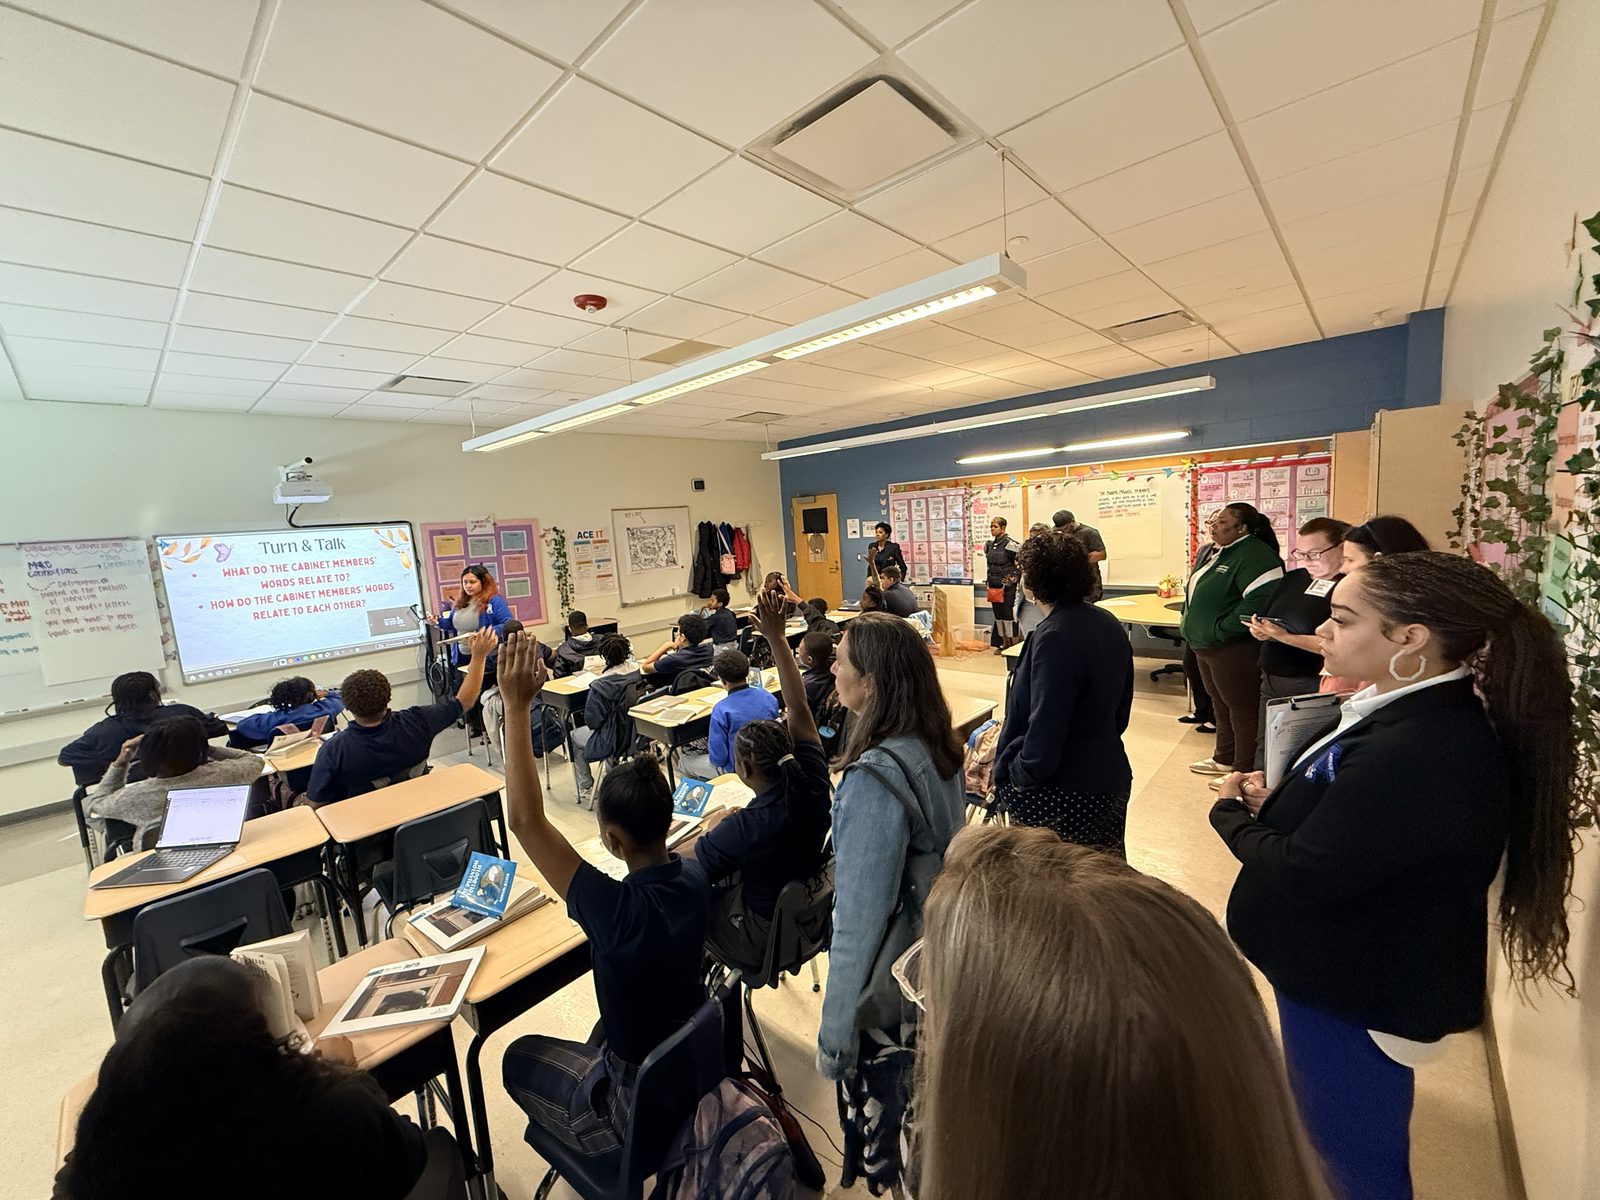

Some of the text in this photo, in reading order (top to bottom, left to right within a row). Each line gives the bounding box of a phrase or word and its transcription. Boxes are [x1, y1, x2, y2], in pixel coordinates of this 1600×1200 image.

[577, 530, 604, 539] ACE IT
[258, 538, 346, 554] Turn & Talk
[222, 566, 250, 577] WHAT
[252, 565, 268, 575] DO
[270, 563, 289, 573] THE
[291, 560, 330, 571] CABINET
[260, 573, 350, 589] WORDS RELATE TO?
[210, 599, 234, 610] HOW
[236, 597, 252, 607] DO
[254, 594, 274, 605] THE
[276, 591, 316, 602] CABINET
[365, 583, 395, 593] WORDS
[252, 600, 366, 620] RELATE TO EACH OTHER?
[466, 860, 479, 886] PHANTOM
